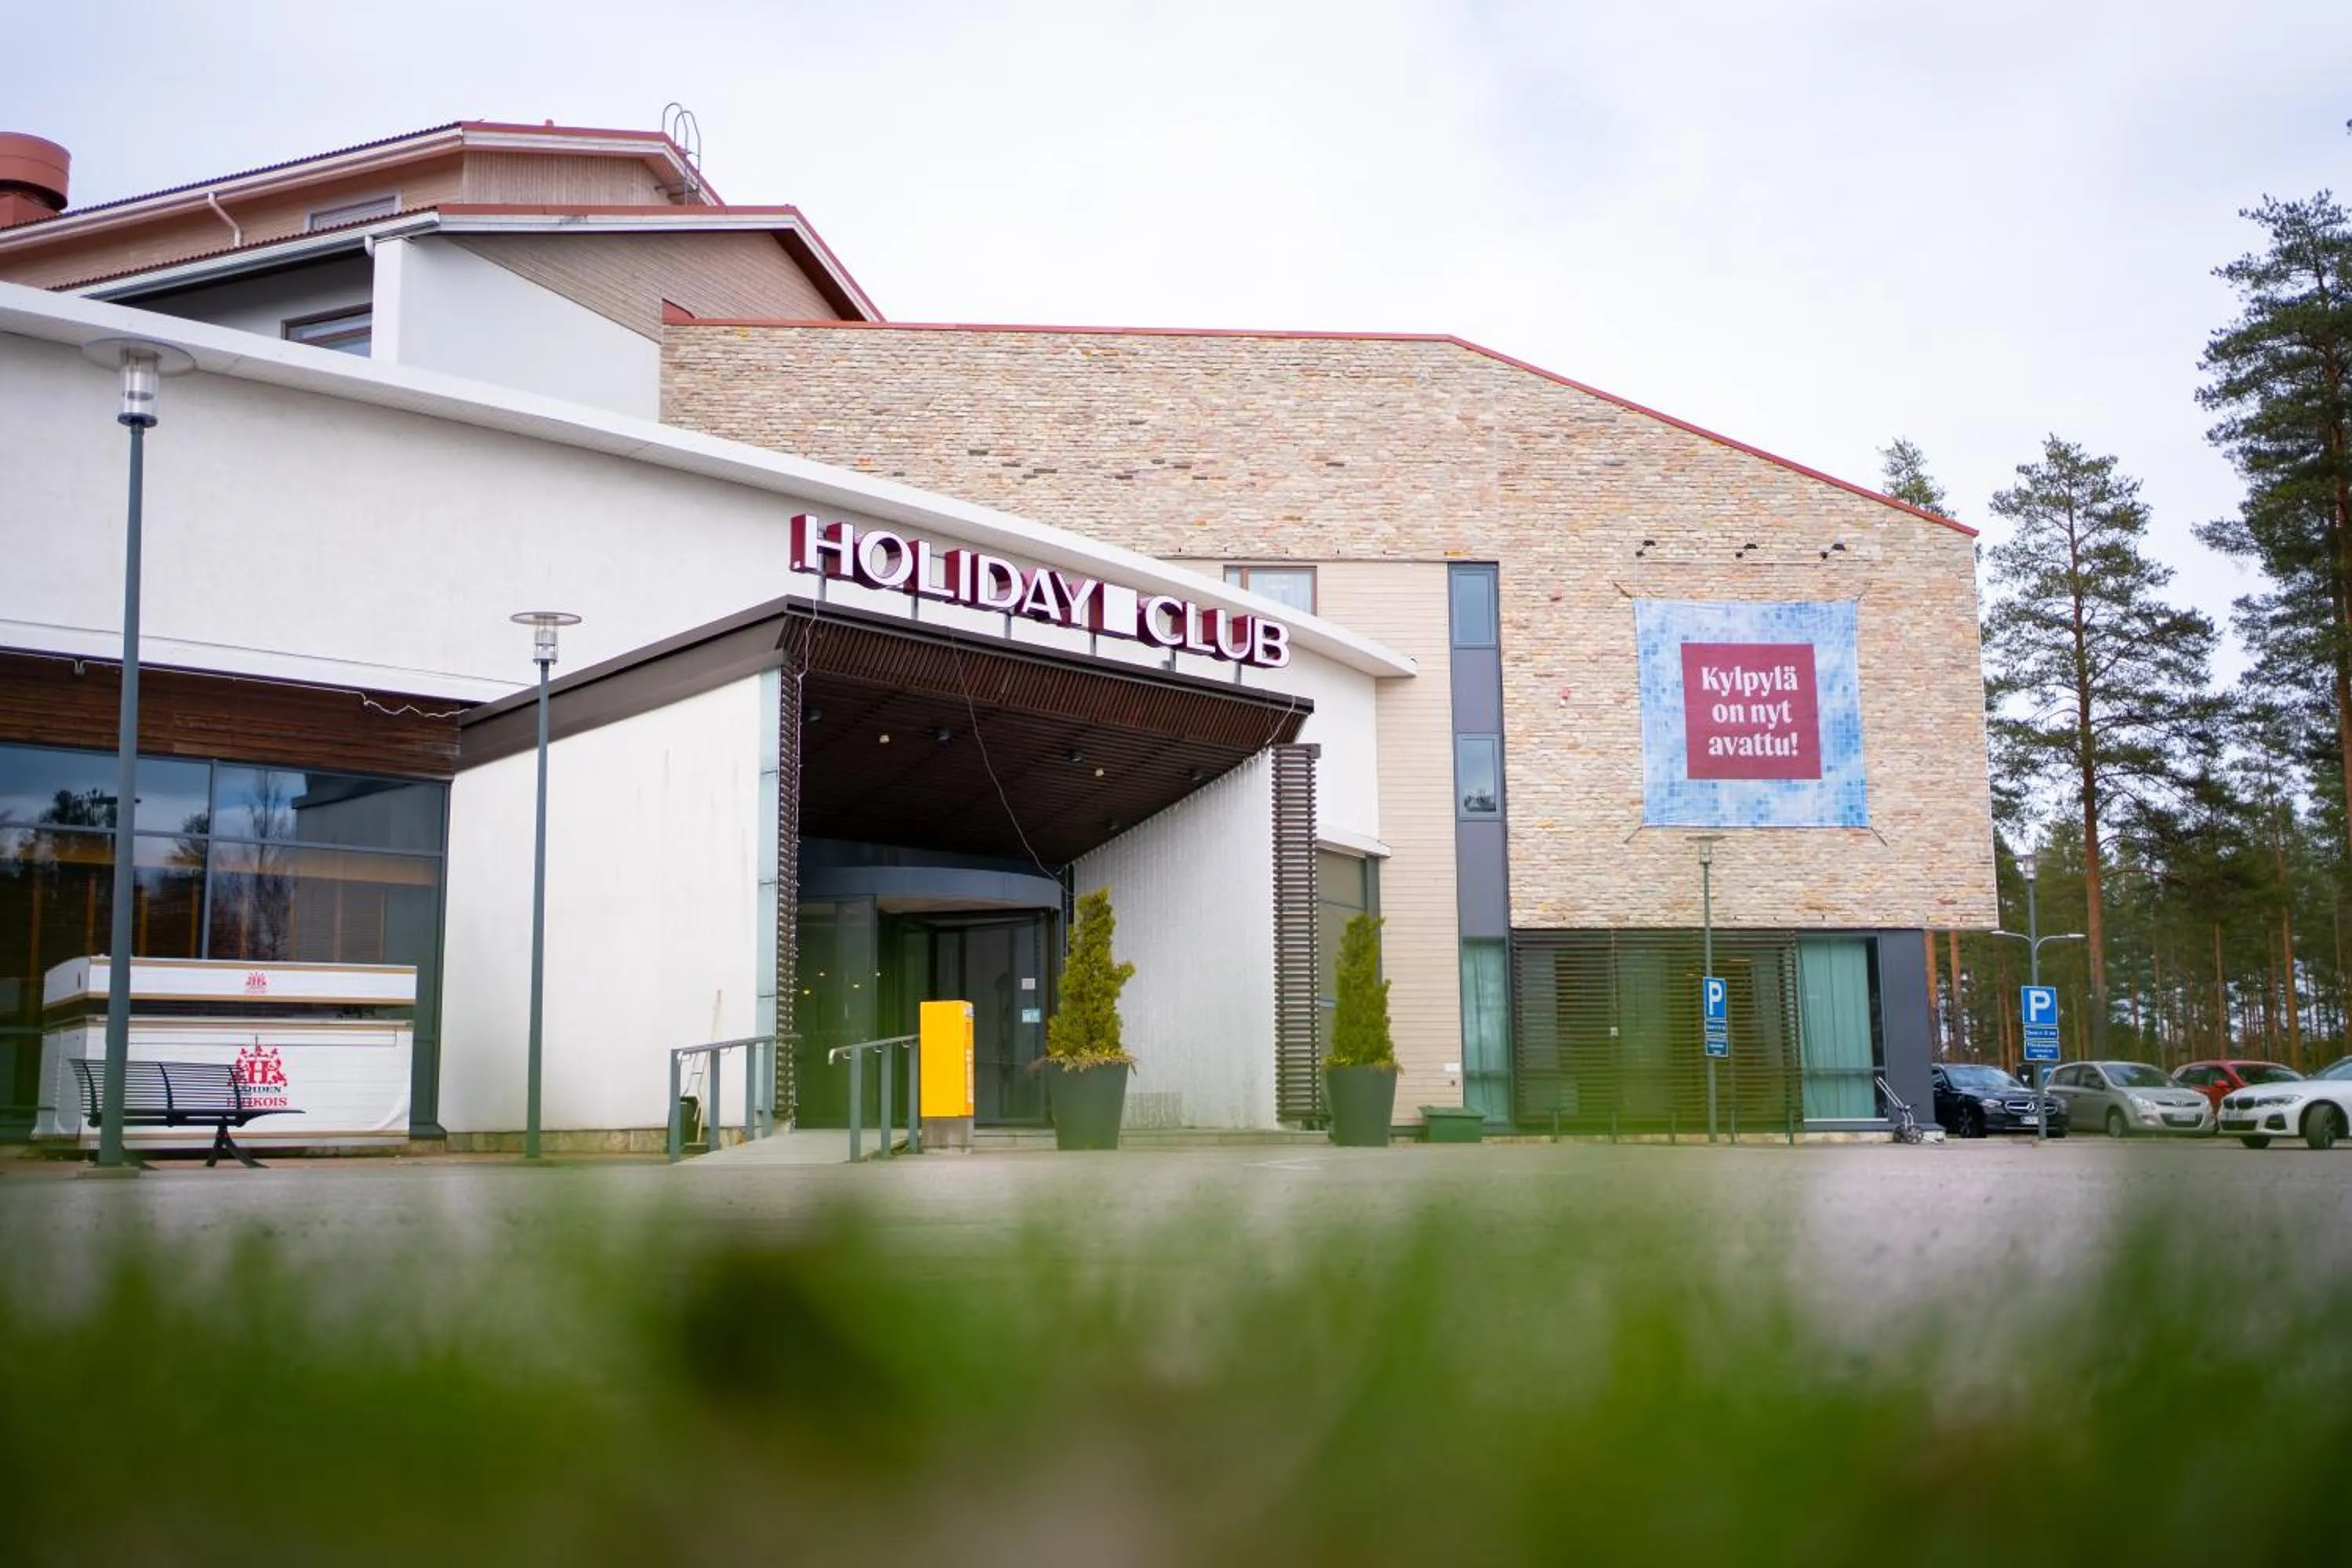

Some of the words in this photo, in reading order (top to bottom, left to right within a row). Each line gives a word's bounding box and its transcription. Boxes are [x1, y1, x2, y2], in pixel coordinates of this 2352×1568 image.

[792, 514, 1098, 627] HOLIDAY
[1141, 595, 1290, 667] CLUB
[1700, 665, 1799, 698] Kylpylä
[1711, 702, 1745, 724] on
[1750, 700, 1793, 729] nyt
[1708, 731, 1799, 757] avattu!
[1708, 981, 1723, 1016] P
[2029, 989, 2052, 1022] P
